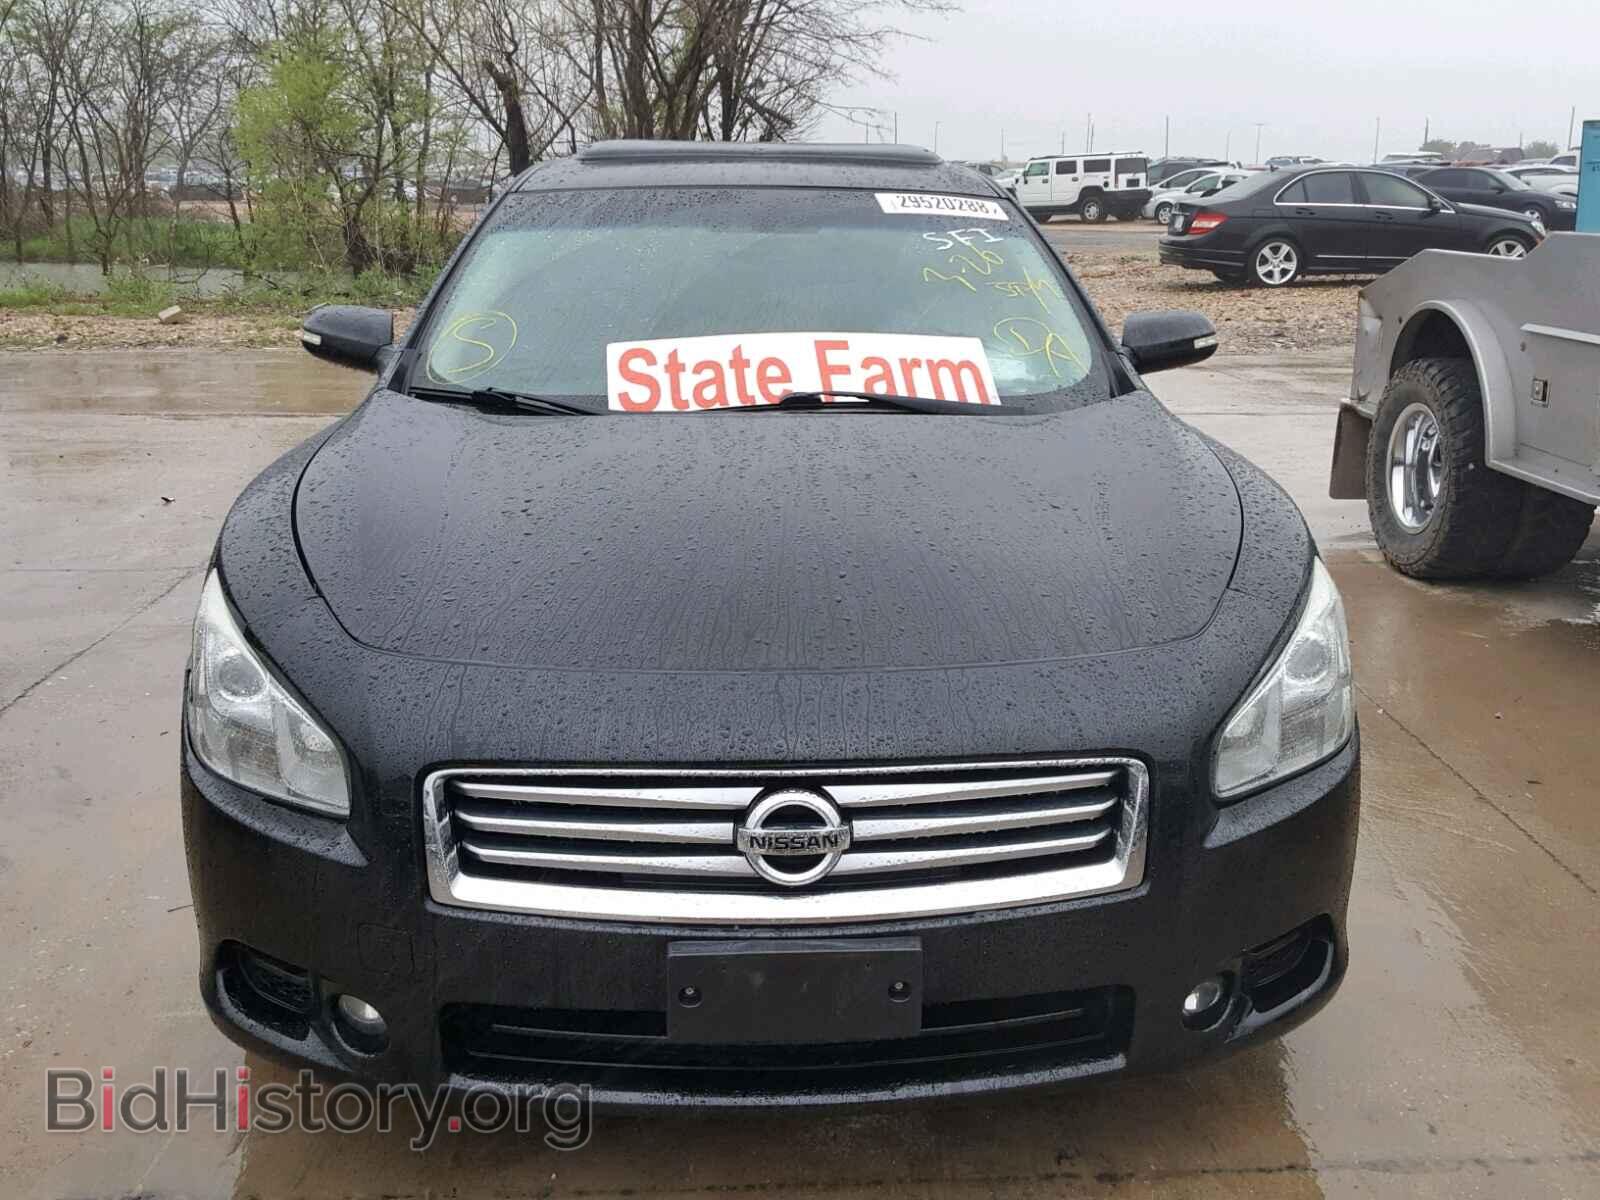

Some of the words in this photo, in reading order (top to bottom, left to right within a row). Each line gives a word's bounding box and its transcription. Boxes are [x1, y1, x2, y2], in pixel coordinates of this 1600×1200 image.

[617, 345, 793, 412] State
[813, 339, 993, 405] Farm
[749, 834, 839, 850] NISSAN
